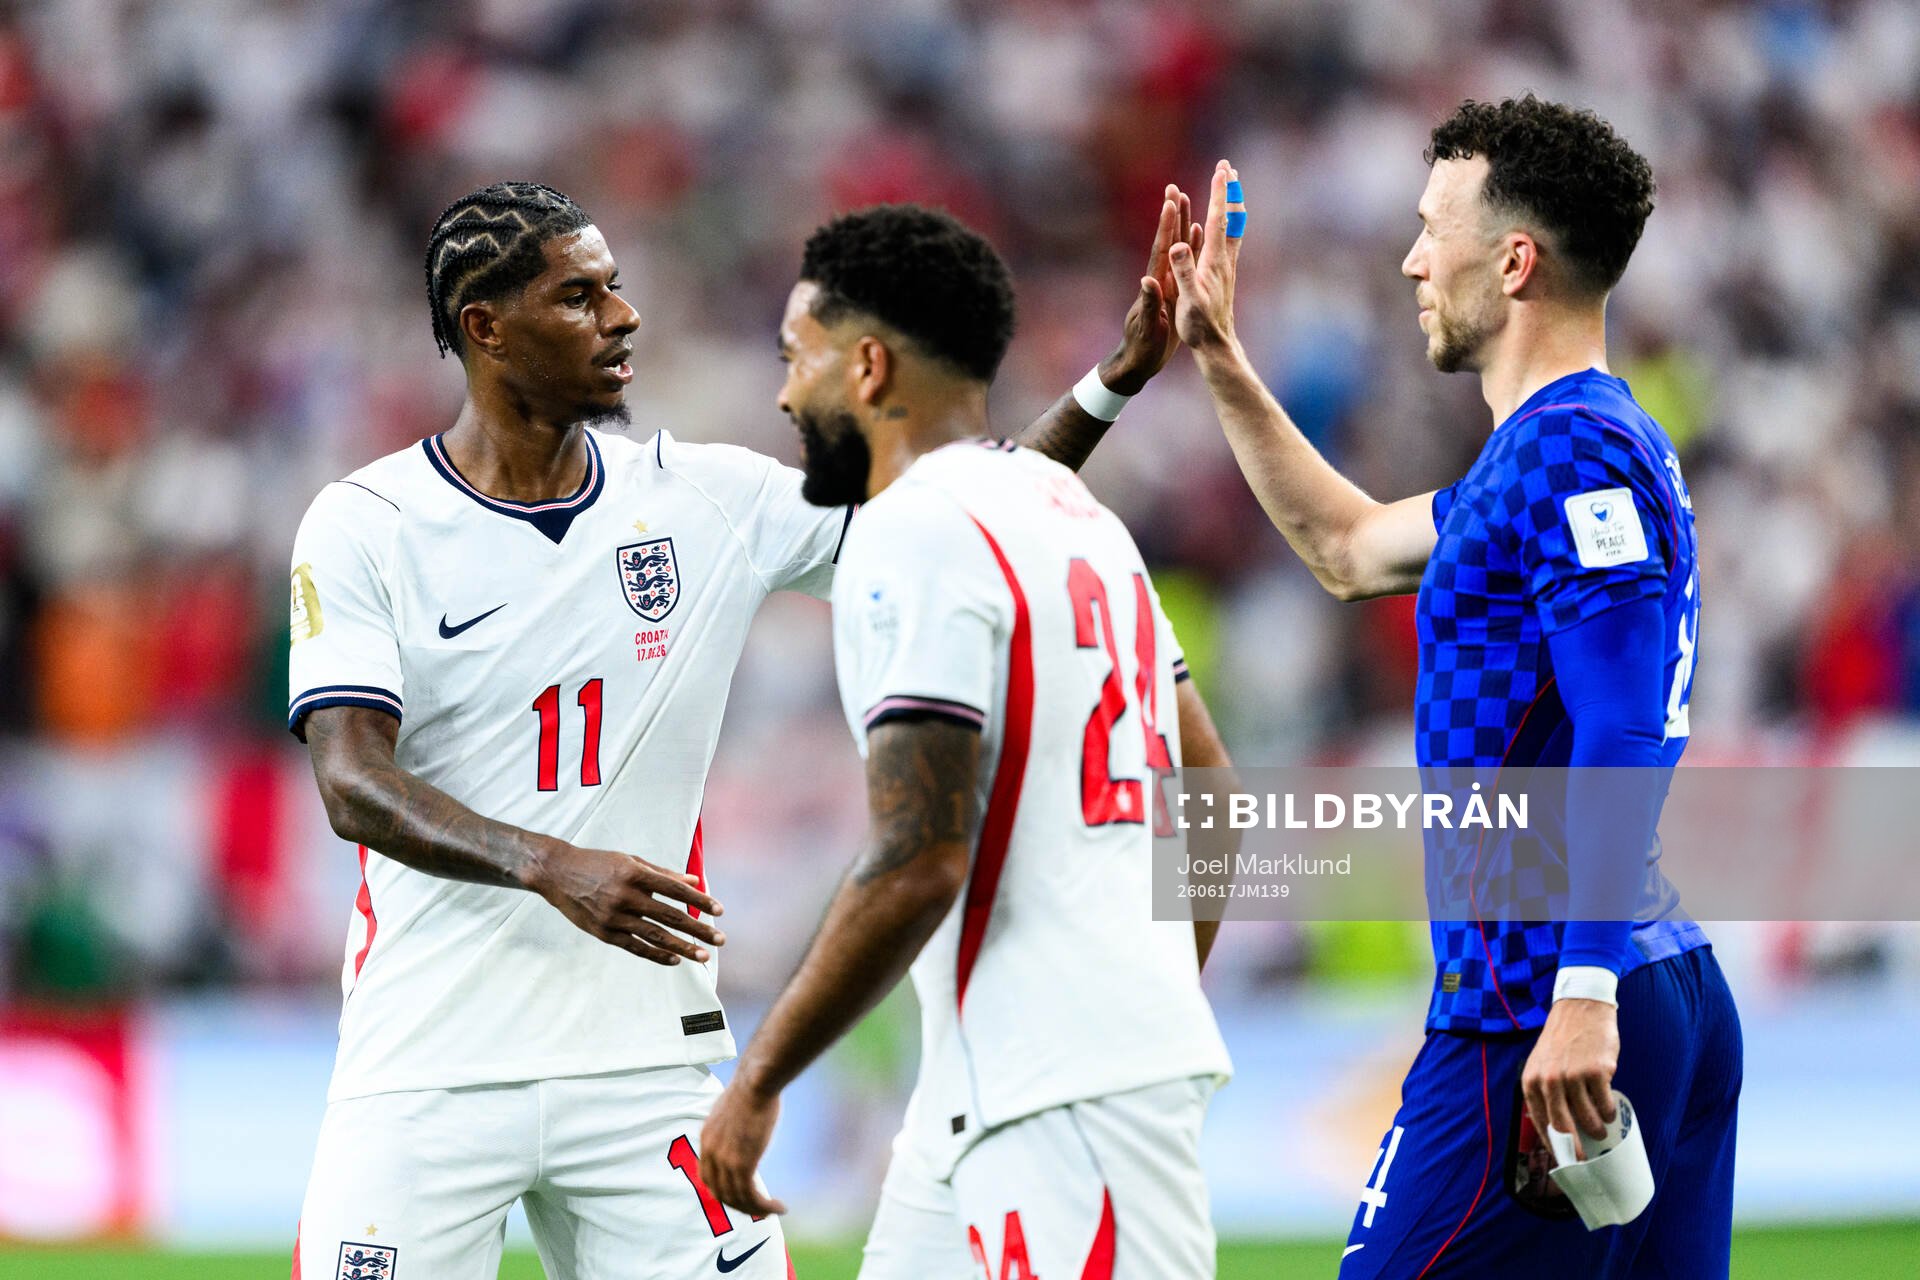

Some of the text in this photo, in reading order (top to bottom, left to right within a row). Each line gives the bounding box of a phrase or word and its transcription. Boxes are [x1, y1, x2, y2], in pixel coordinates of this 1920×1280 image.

[532, 678, 603, 792] 11
[1067, 557, 1178, 838] 24
[667, 1134, 766, 1237] 1
